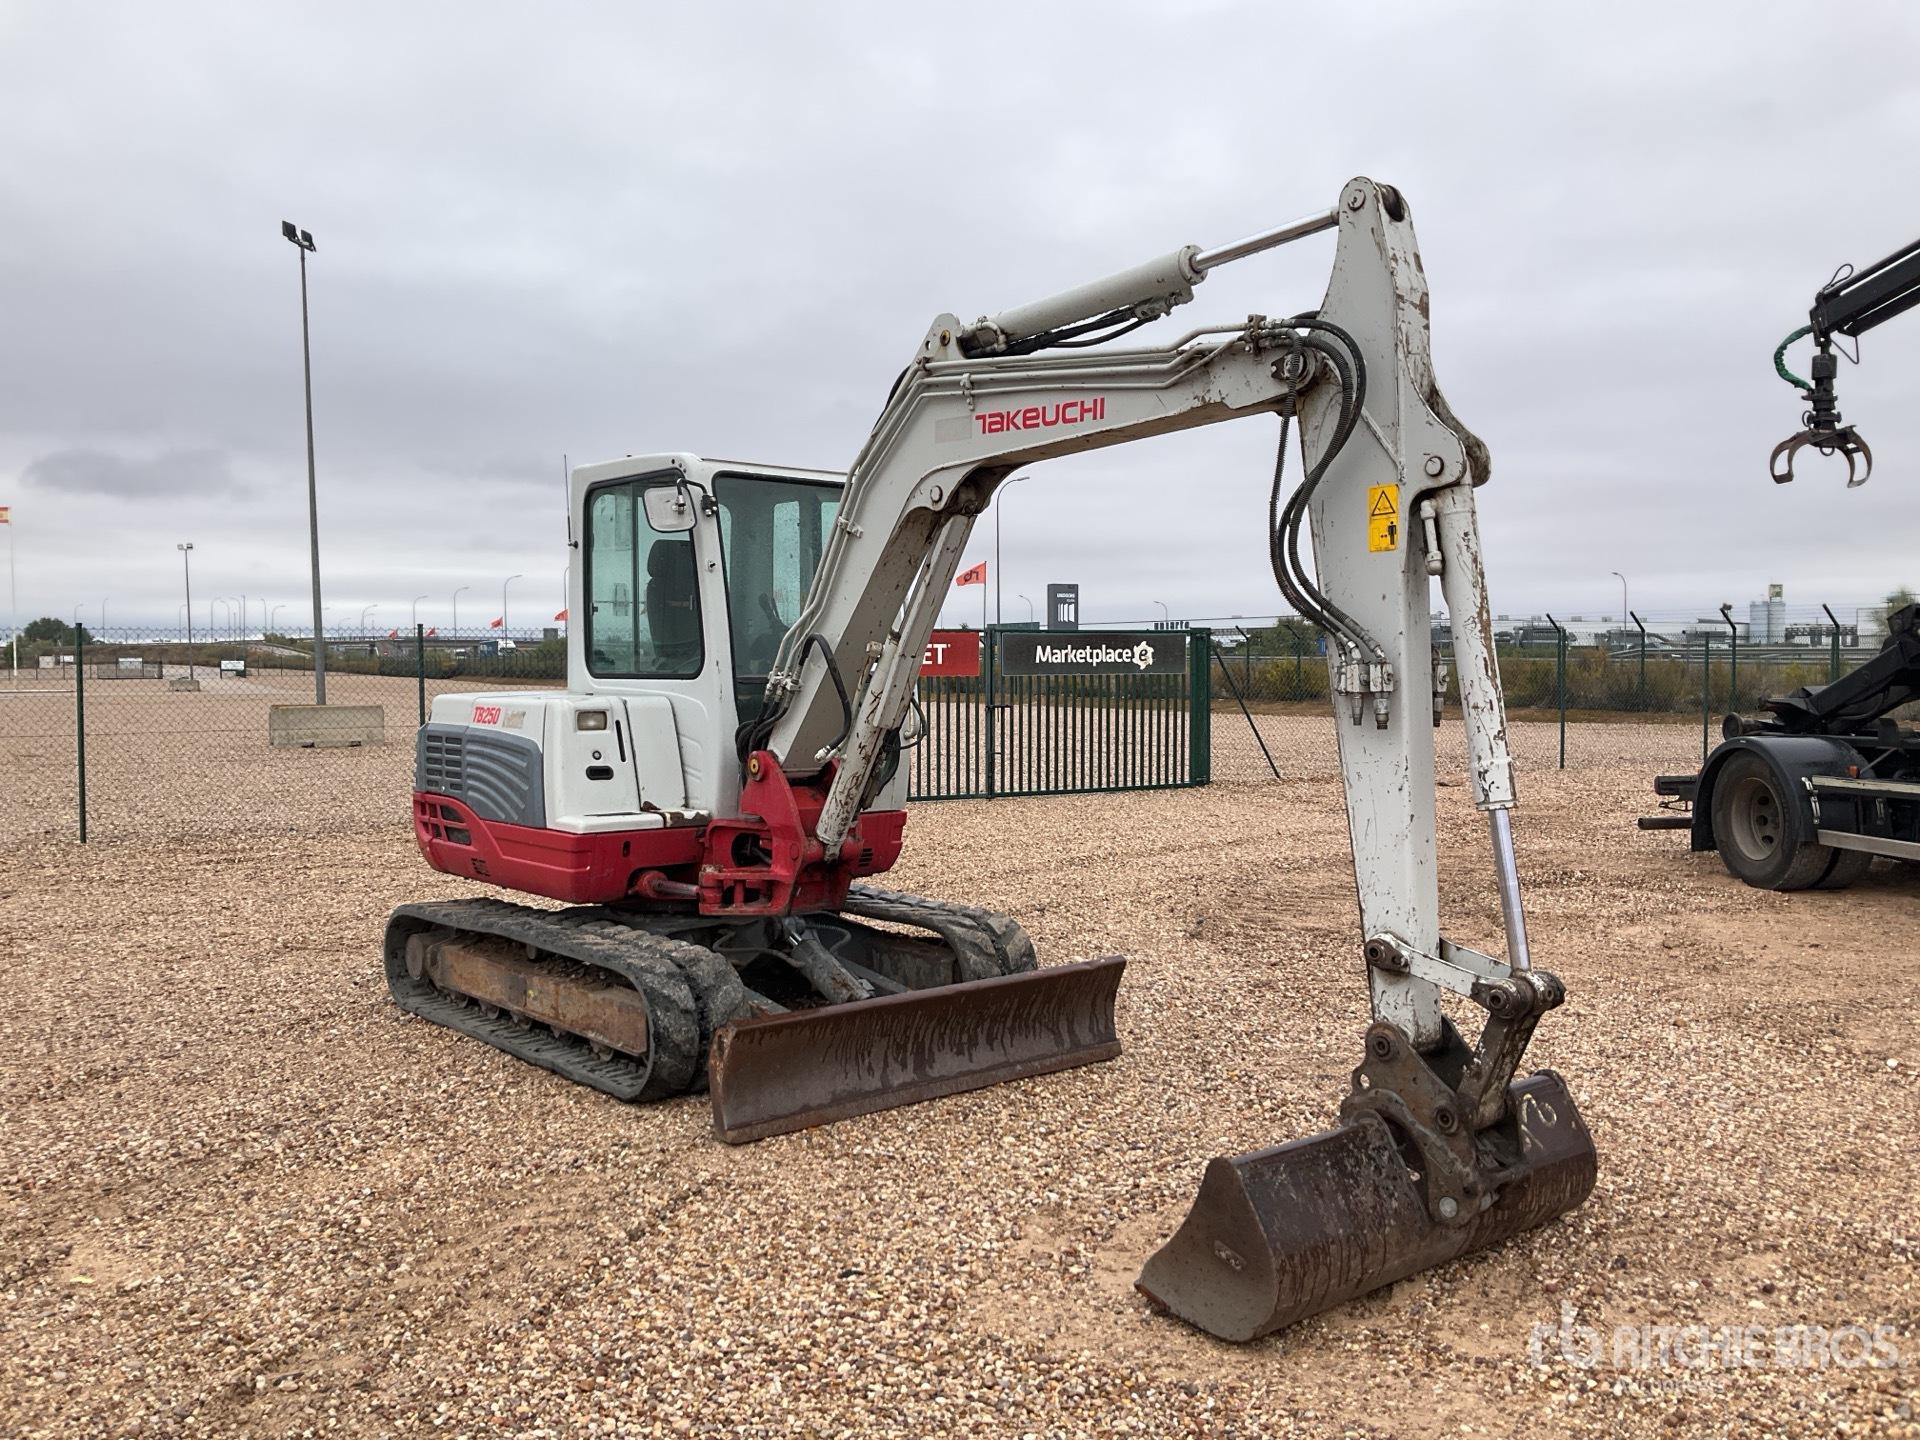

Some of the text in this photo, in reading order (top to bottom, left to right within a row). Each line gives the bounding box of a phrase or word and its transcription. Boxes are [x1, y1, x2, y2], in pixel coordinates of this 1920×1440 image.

[922, 643, 947, 664] ET
[1035, 644, 1132, 667] Marketplace
[472, 705, 501, 725] TB250
